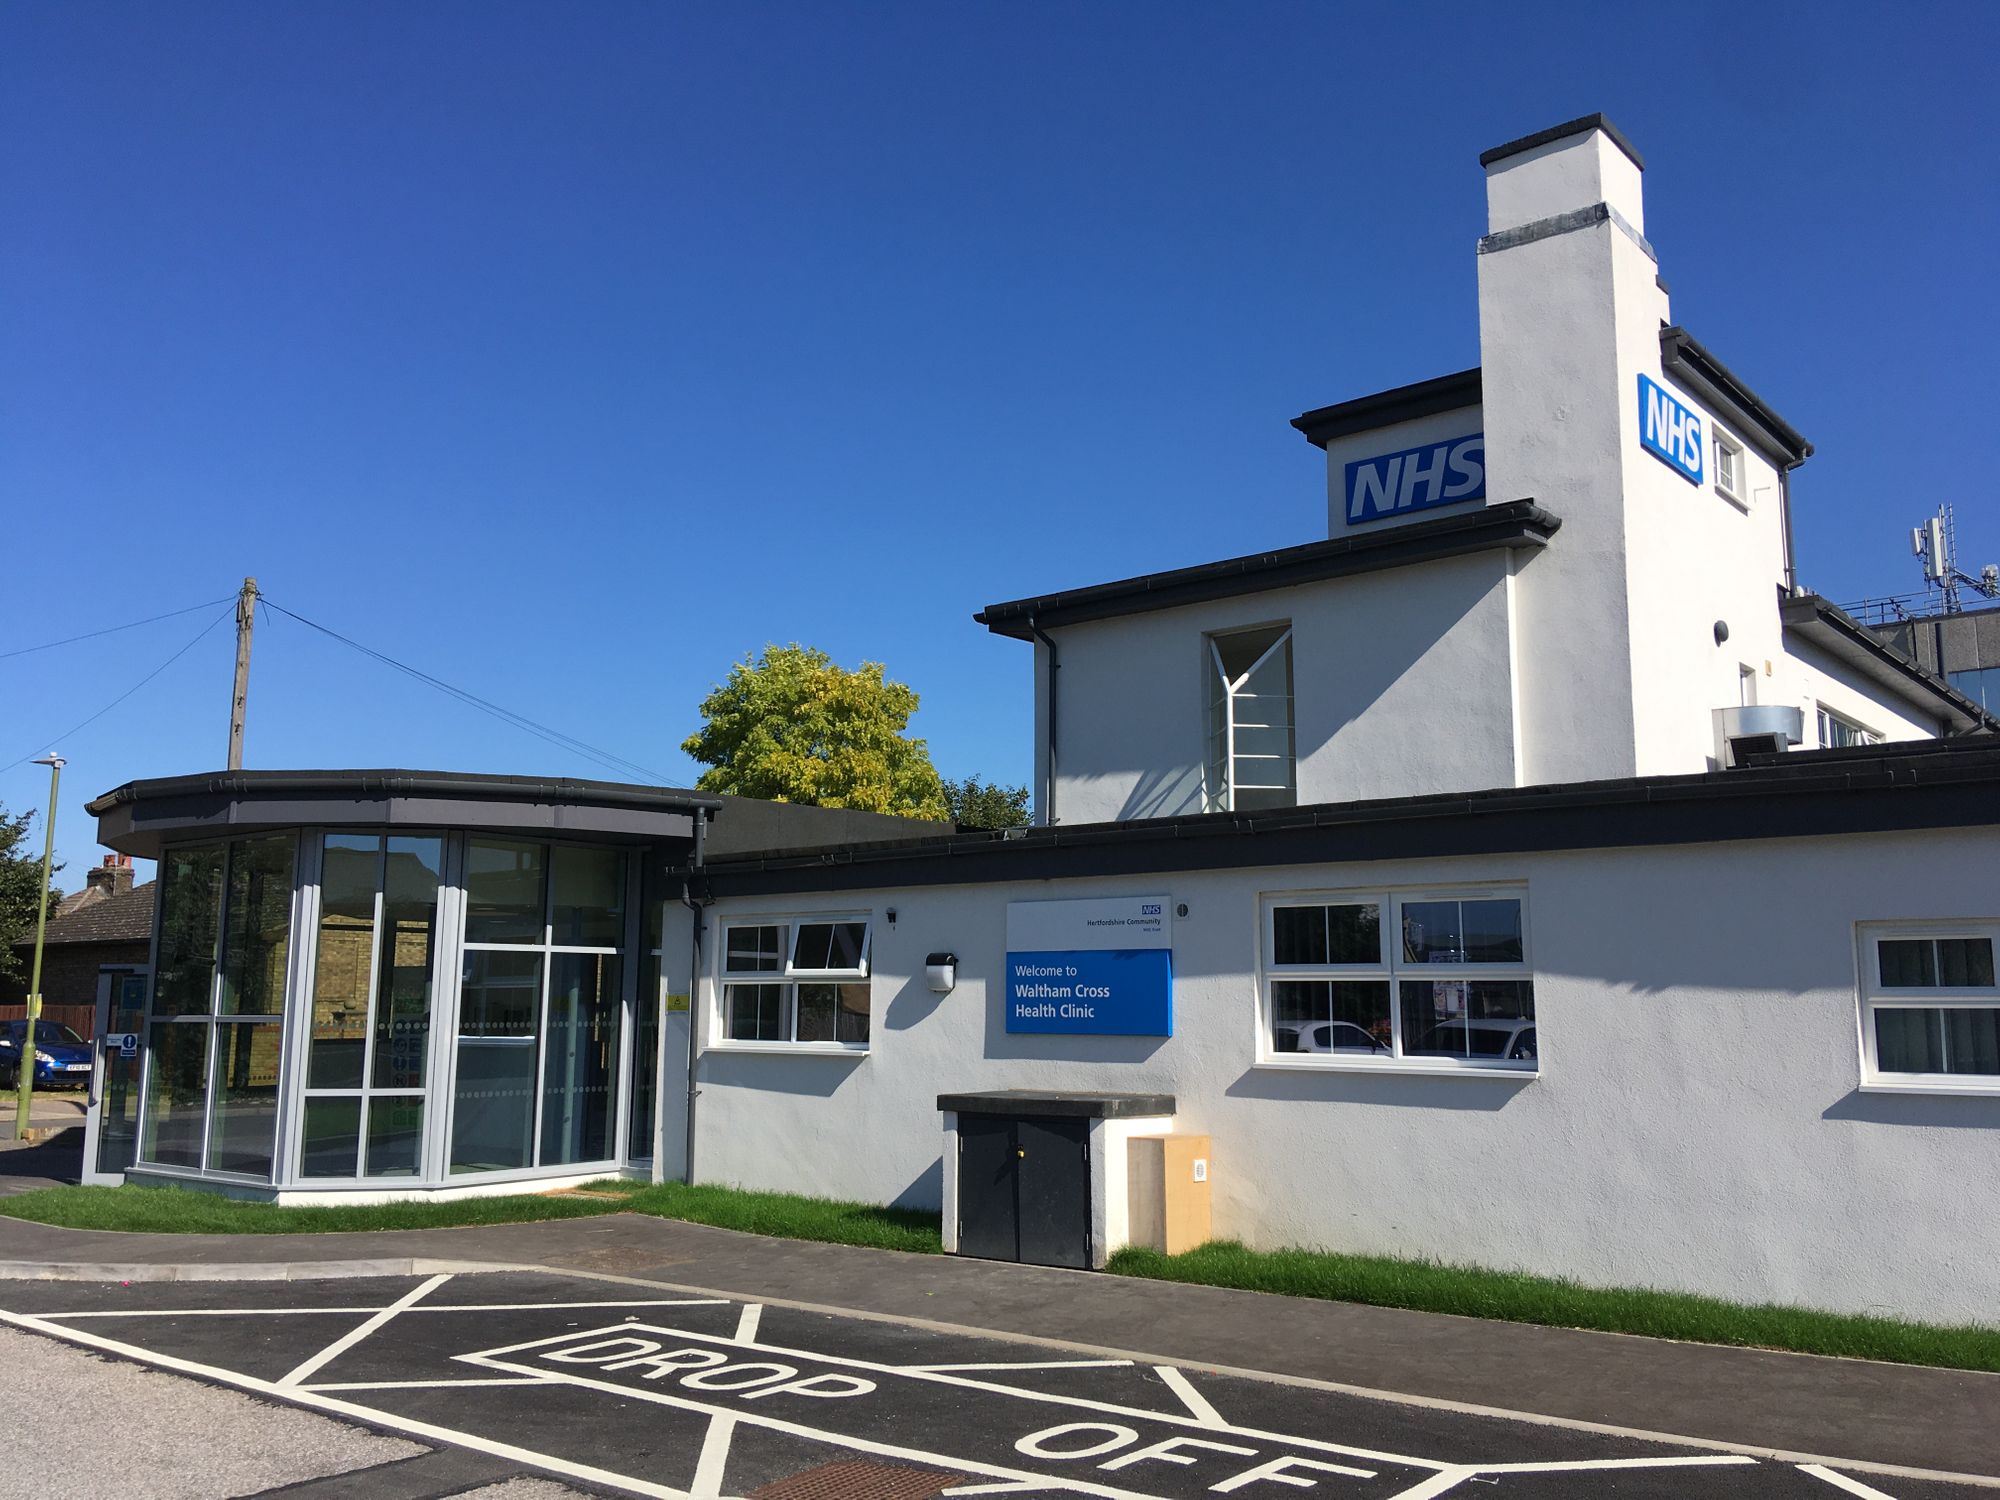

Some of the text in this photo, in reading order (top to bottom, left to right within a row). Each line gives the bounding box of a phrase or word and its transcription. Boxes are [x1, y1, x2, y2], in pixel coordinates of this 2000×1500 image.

[1646, 383, 1701, 474] NHS
[1350, 438, 1485, 518] NHS
[1142, 905, 1160, 914] NHS
[1087, 918, 1160, 926] Hertfordshire Community
[1015, 965, 1077, 977] Welcome to
[1015, 984, 1110, 998] Waltham Cross
[1015, 1004, 1095, 1018] Health Clinic
[538, 1337, 1378, 1494] DROP OFF
